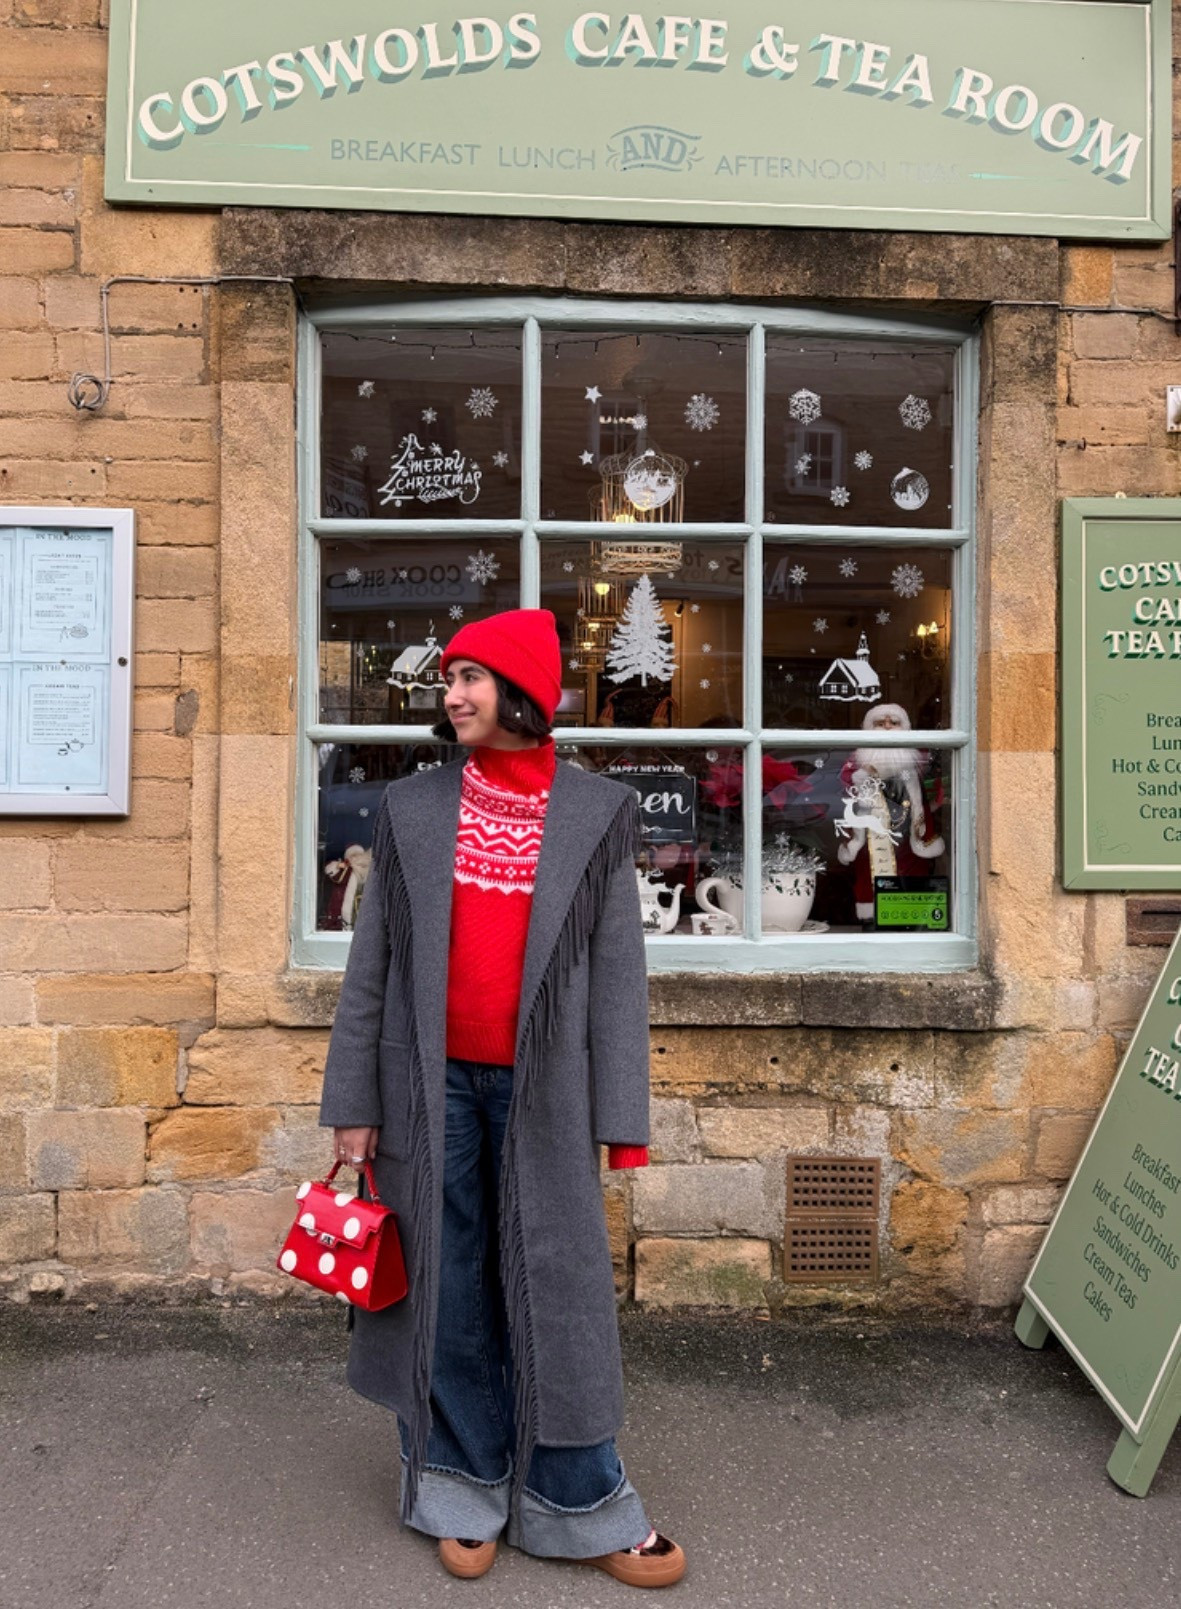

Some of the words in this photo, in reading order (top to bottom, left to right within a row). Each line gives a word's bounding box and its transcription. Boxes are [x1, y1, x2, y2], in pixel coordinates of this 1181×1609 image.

[138, 13, 541, 150] COTSWOLDS
[566, 12, 728, 71] CAFE
[743, 25, 800, 79] &
[809, 33, 934, 108] TEA
[942, 66, 1143, 185] ROOM
[330, 139, 482, 166] BREAKFAST
[500, 146, 596, 171] LUNCH
[621, 132, 687, 165] AND
[715, 155, 886, 181] AFTERNOON
[409, 449, 465, 474] MERRY
[1103, 630, 1166, 659] TEA
[609, 764, 638, 773] HAPPY
[641, 764, 661, 773] NEW
[662, 764, 685, 773] YEAR
[1112, 758, 1142, 773] Hot
[1147, 758, 1160, 773] &
[1137, 780, 1181, 796] Sand
[1140, 1046, 1180, 1094] TEA
[1131, 1142, 1181, 1194] Breakfast
[1123, 1171, 1167, 1219] Lunches
[1092, 1178, 1112, 1206] Hot
[1109, 1195, 1120, 1215] &
[1119, 1203, 1146, 1236] Cold
[1141, 1223, 1180, 1270] Drinks
[1093, 1215, 1151, 1282] Sandwiches
[1083, 1242, 1115, 1285] Cream
[1113, 1272, 1138, 1309] Teas
[1083, 1281, 1113, 1322] Cakes
